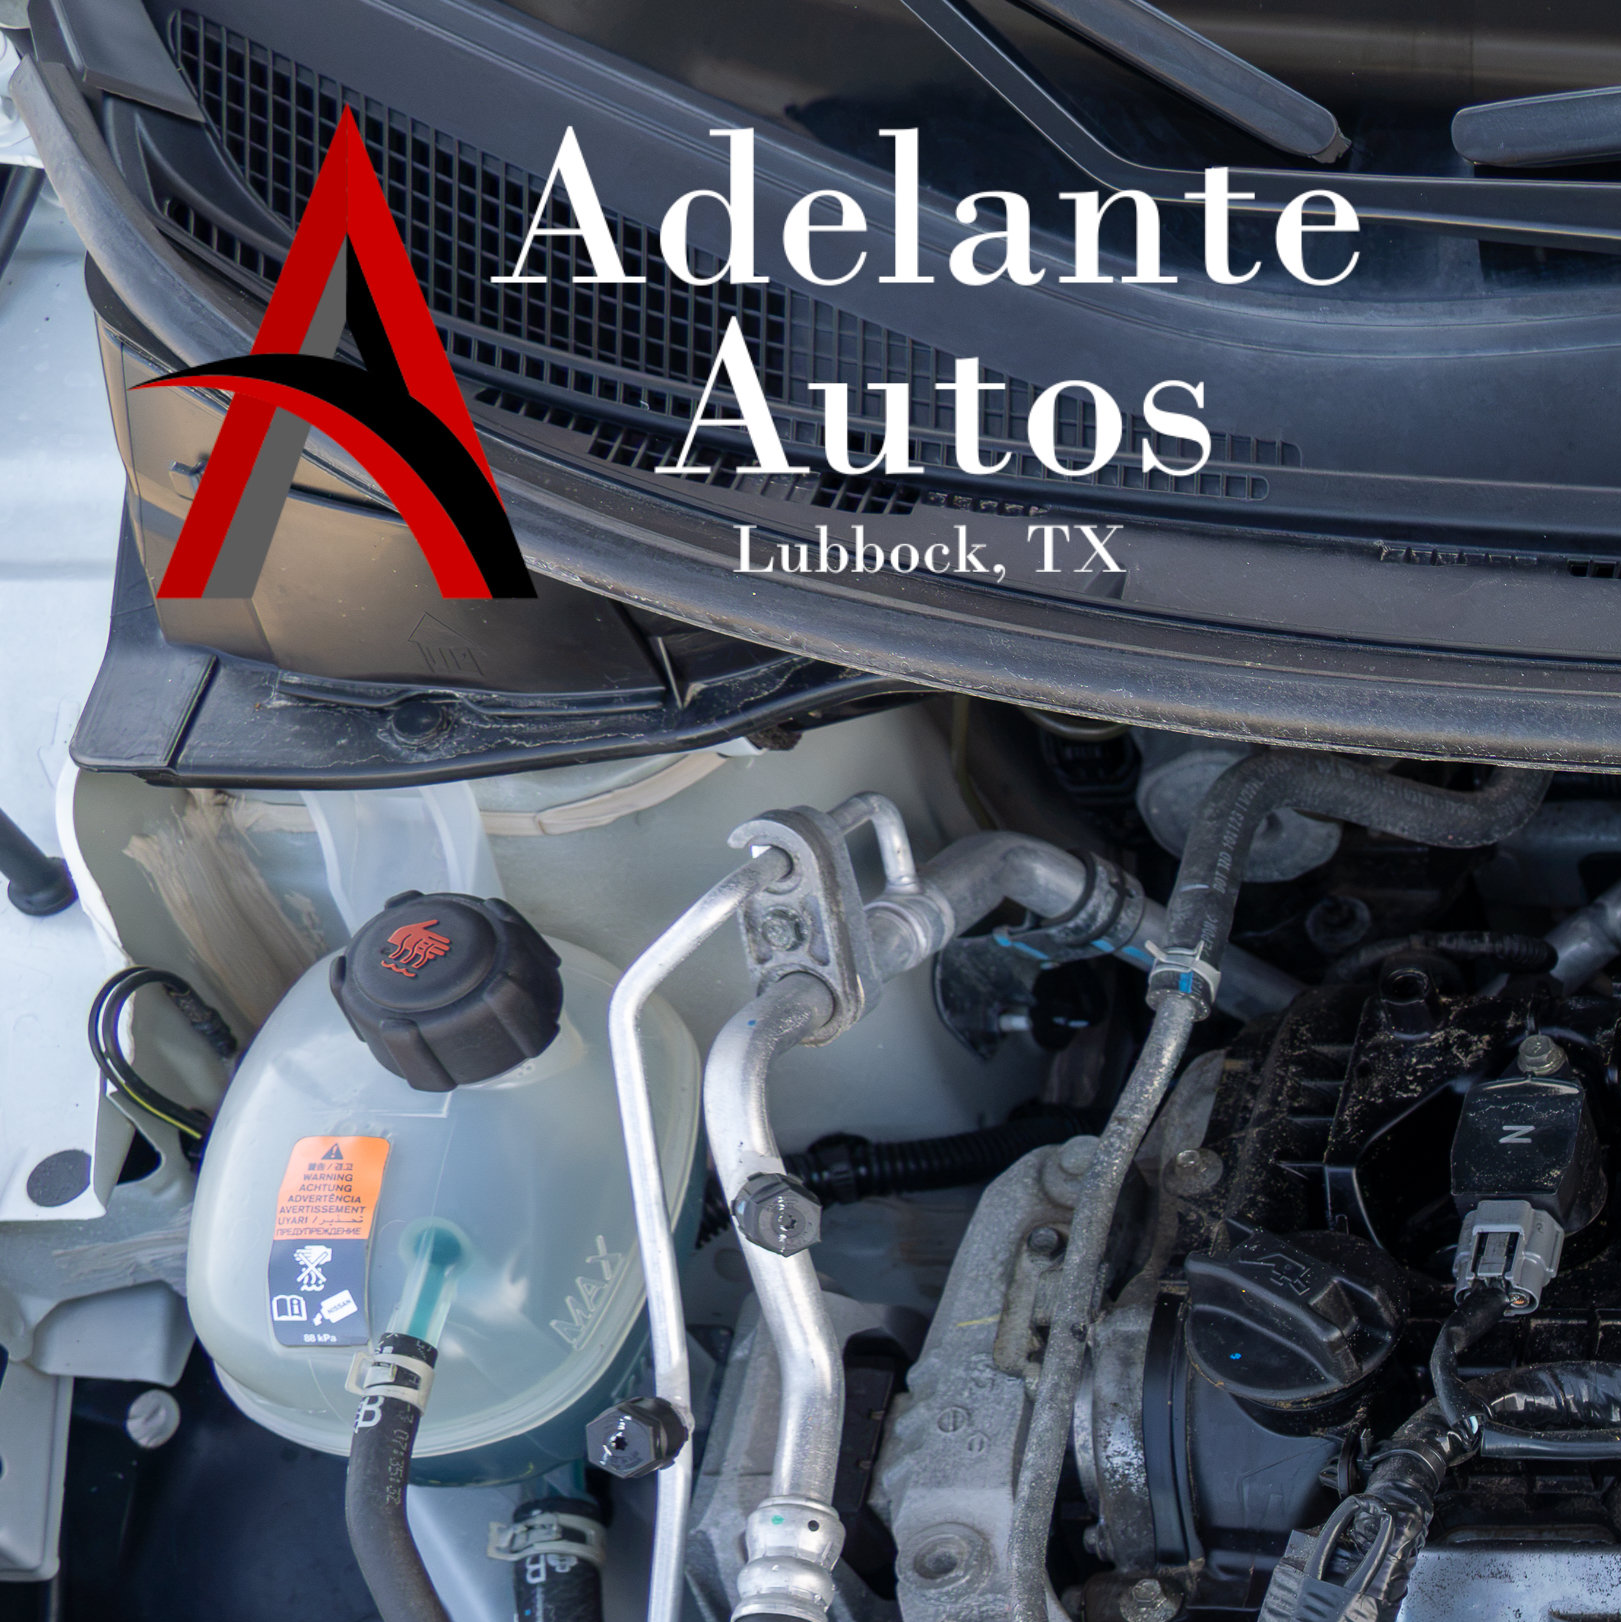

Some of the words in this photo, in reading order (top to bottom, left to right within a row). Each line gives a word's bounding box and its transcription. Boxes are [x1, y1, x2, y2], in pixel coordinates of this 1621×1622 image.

[303, 1173, 353, 1182] WARNING
[299, 1183, 352, 1192] ACHTUNG
[288, 1193, 361, 1203] ADVERTÊNCIA
[279, 1205, 366, 1214] AVERTISSEMENT
[318, 1333, 337, 1343] kPa
